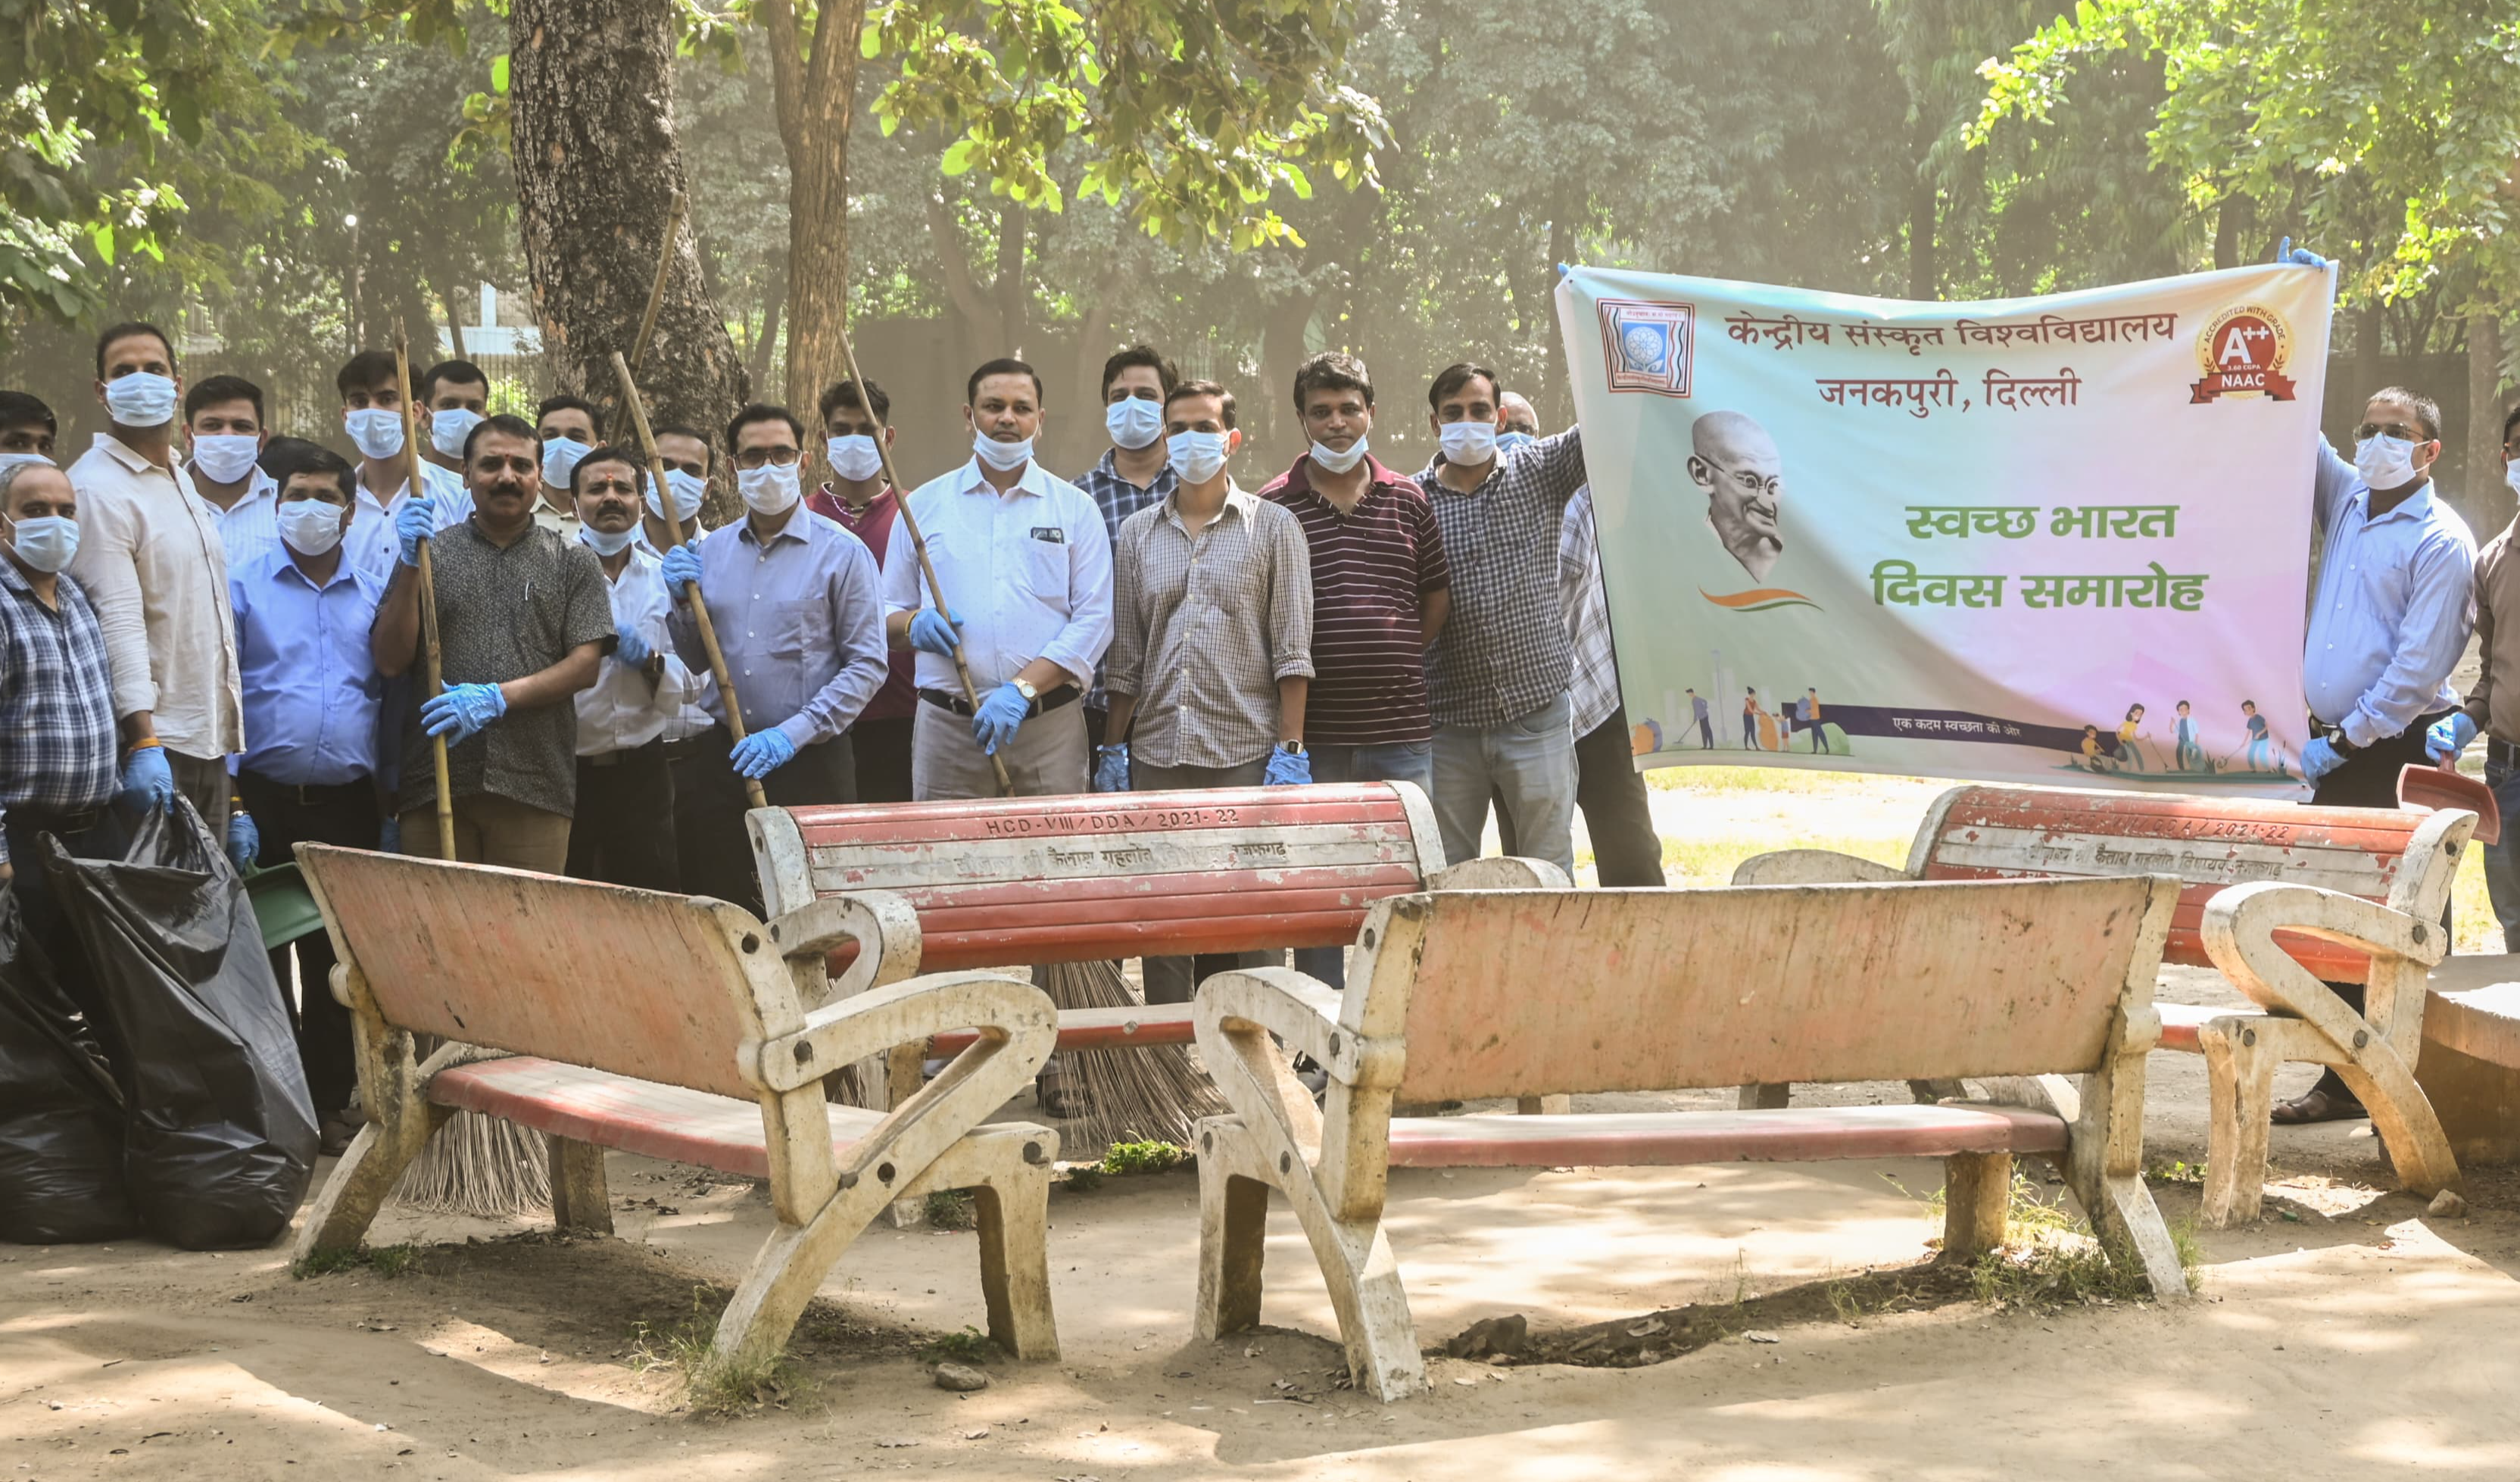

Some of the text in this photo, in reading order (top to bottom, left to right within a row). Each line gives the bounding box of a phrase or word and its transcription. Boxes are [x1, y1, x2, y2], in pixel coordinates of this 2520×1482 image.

[1724, 310, 2178, 356] केन्द्रीय संस्कृत विश्वविद्यालय
[2204, 305, 2286, 344] ACCREDITED WITH GRADE
[2219, 326, 2269, 365] A++
[1982, 367, 2082, 411] दिल्ली
[2221, 373, 2266, 388] NAAC
[1905, 505, 2180, 538] स्वच्छ भारत
[1870, 559, 2210, 611] दिवस समारोह
[1892, 717, 1912, 731] एक
[1913, 719, 1941, 732] कदम
[1943, 719, 1983, 733] स्वच्छता
[1985, 721, 2001, 735] की
